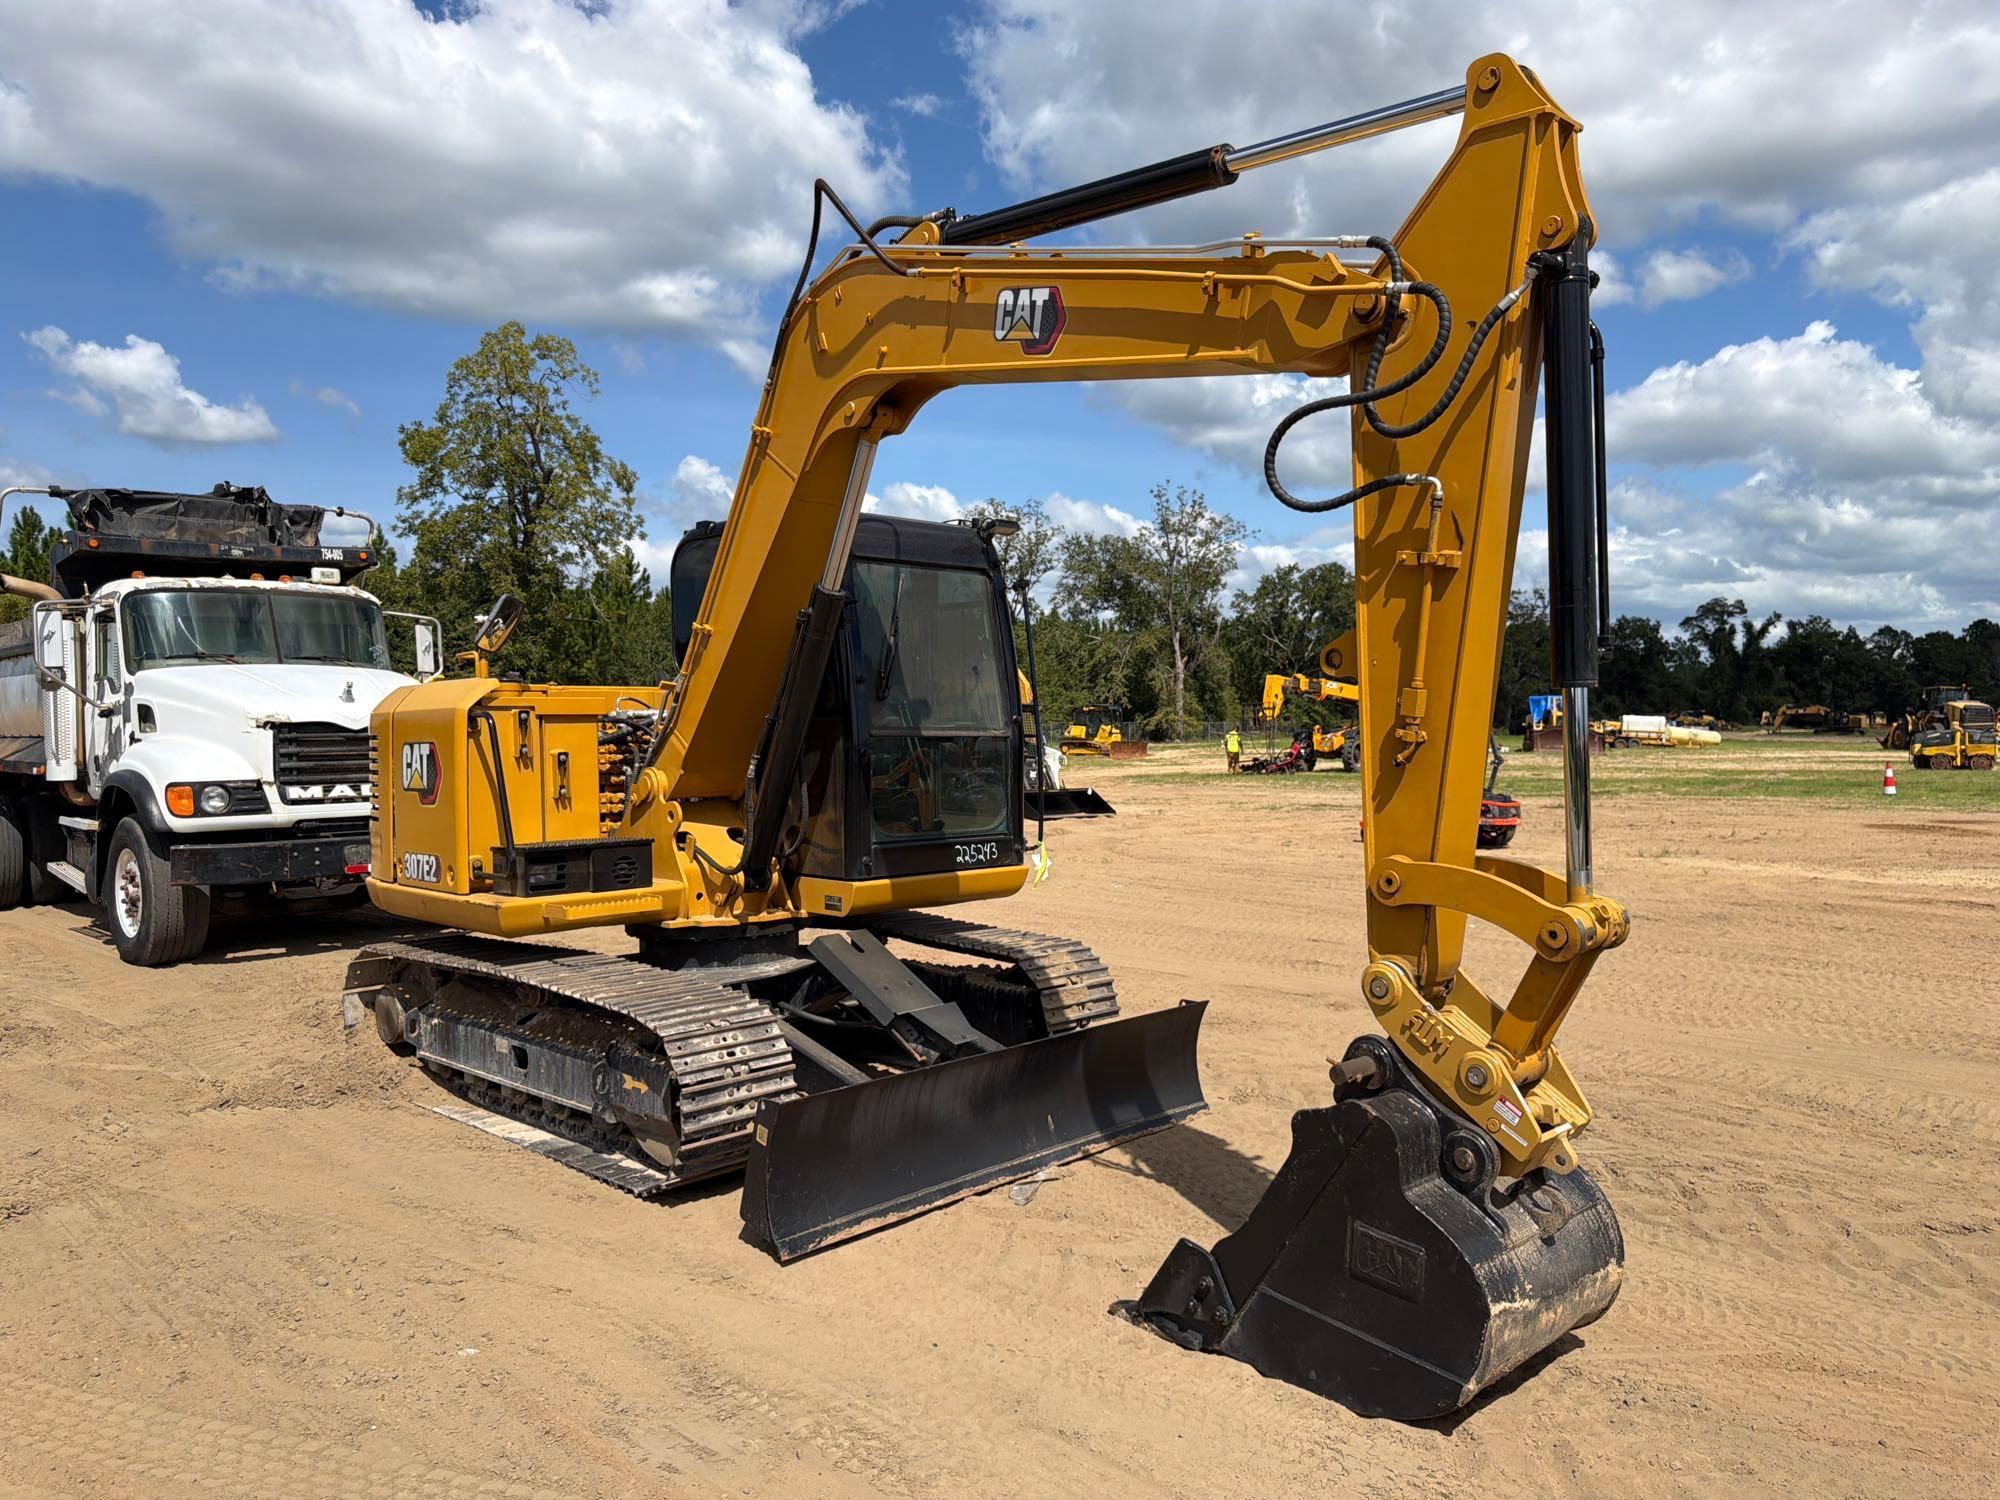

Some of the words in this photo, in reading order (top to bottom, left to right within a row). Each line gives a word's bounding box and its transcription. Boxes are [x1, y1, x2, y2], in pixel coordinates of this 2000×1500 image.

[995, 288, 1050, 341] CAT
[402, 743, 430, 790] CAT
[286, 783, 373, 800] MA
[404, 852, 437, 883] 307E2
[955, 842, 998, 864] 225243
